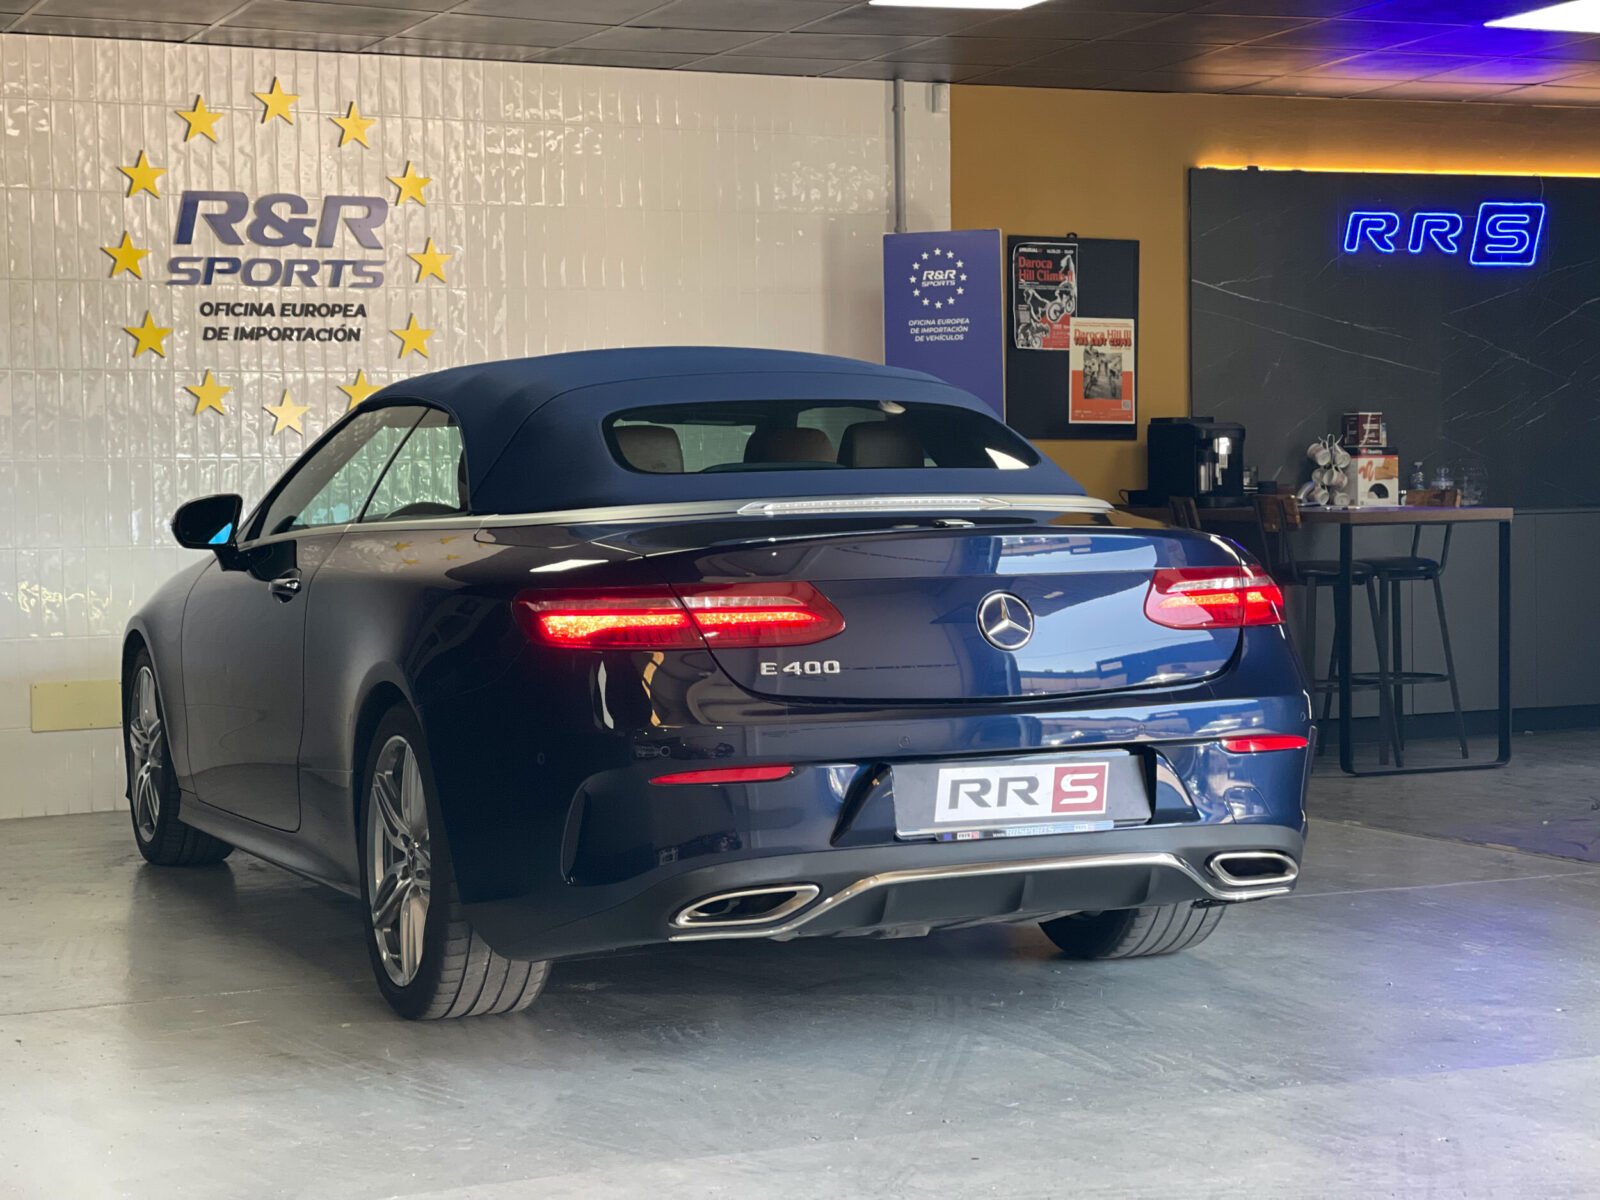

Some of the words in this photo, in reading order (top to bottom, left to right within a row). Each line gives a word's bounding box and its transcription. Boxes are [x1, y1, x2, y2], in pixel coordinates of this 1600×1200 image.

[173, 190, 388, 250] R&R
[1018, 256, 1053, 269] Daroca
[166, 256, 386, 289] SPORTS
[922, 270, 957, 280] R&R
[1019, 269, 1035, 281] Hill
[199, 301, 276, 318] OFICINA
[279, 302, 367, 319] EUROPEA
[937, 317, 970, 325] EUROPEA
[202, 326, 229, 342] DE
[233, 323, 361, 343] IMPORTACIÓN
[921, 325, 969, 334] IMPORTACIÓN
[914, 335, 925, 343] DE
[926, 333, 964, 342] VEHÍCULOS
[760, 662, 778, 675] E
[782, 660, 840, 675] 400
[948, 772, 1099, 810] RRS
